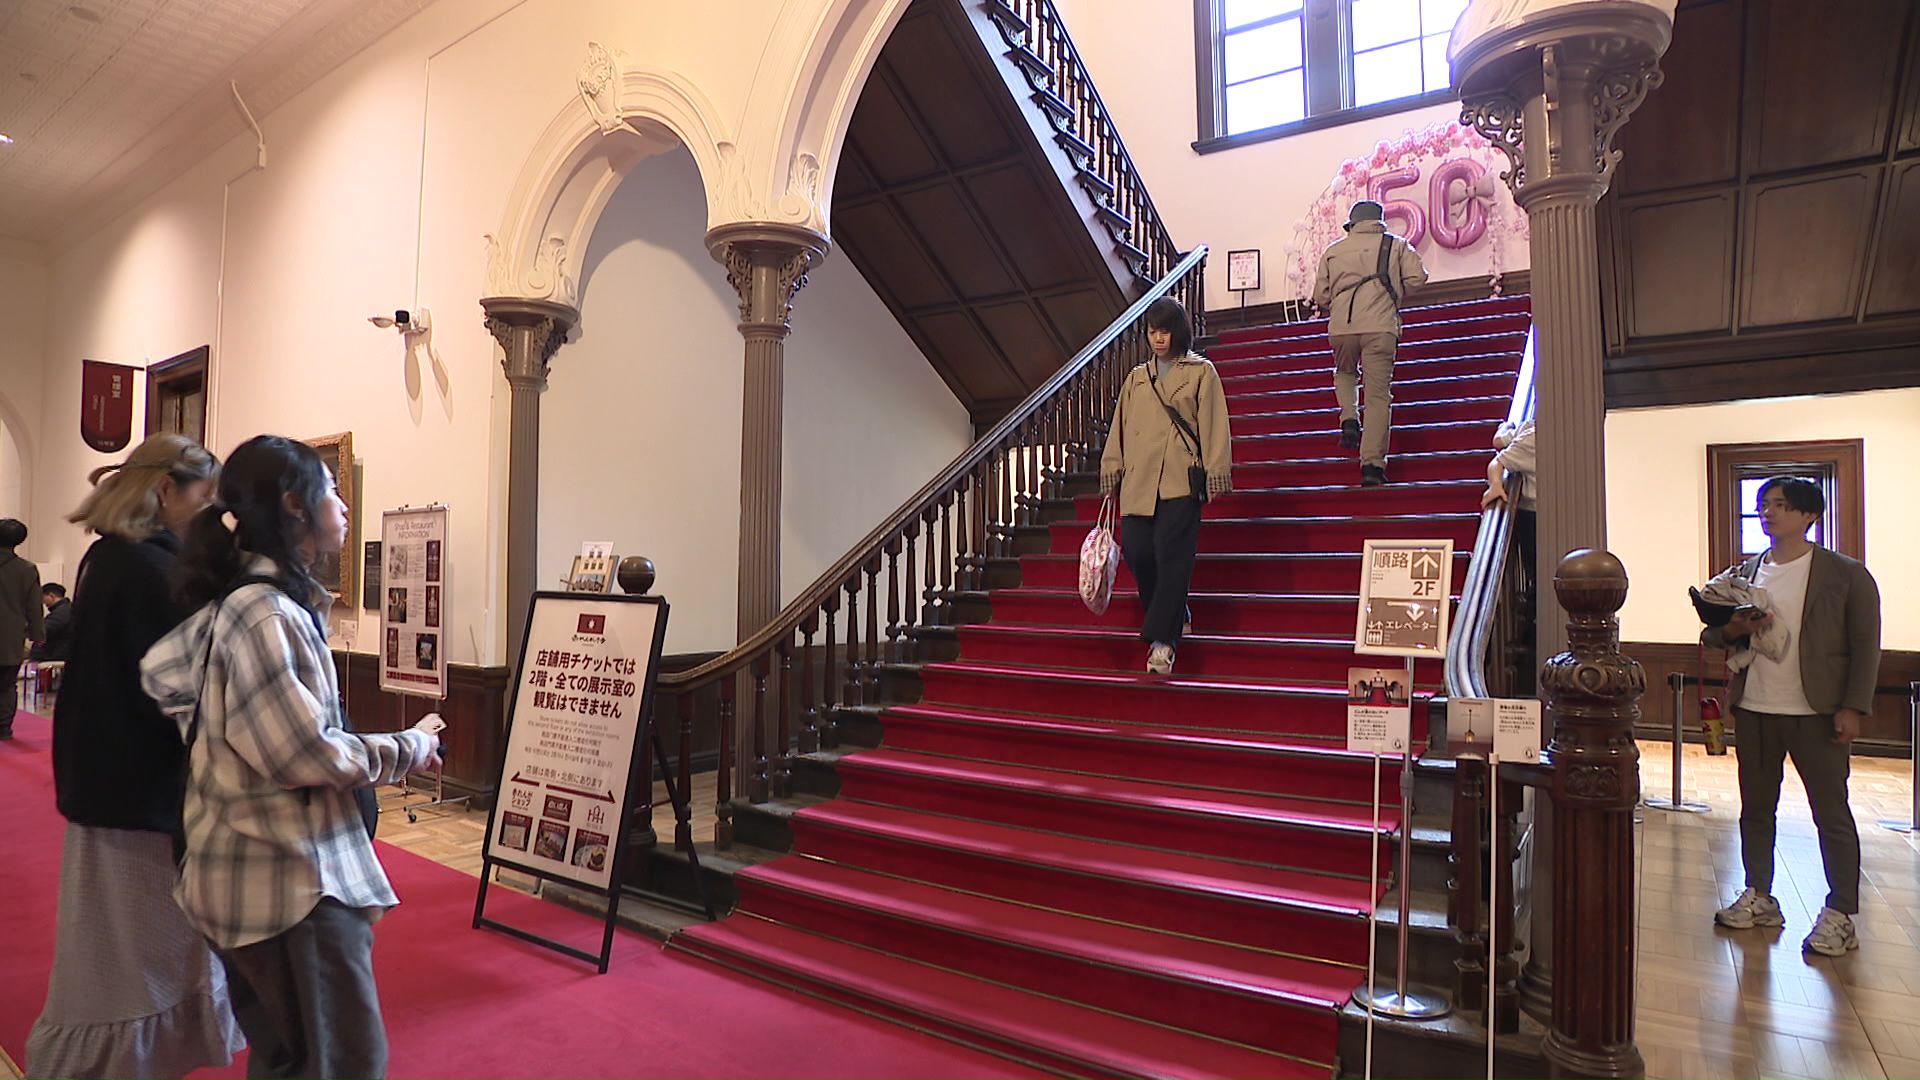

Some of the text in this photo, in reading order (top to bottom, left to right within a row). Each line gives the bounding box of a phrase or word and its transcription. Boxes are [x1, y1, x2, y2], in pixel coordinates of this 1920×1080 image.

[1367, 158, 1488, 249] 50
[1373, 551, 1409, 568] 順路
[1412, 581, 1436, 596] 2F
[1385, 620, 1438, 631] エレベーター
[535, 648, 636, 676] 店舗用チケットでは
[528, 670, 636, 698] 2階・全ての展示室の
[533, 690, 622, 719] 観覧はできません
